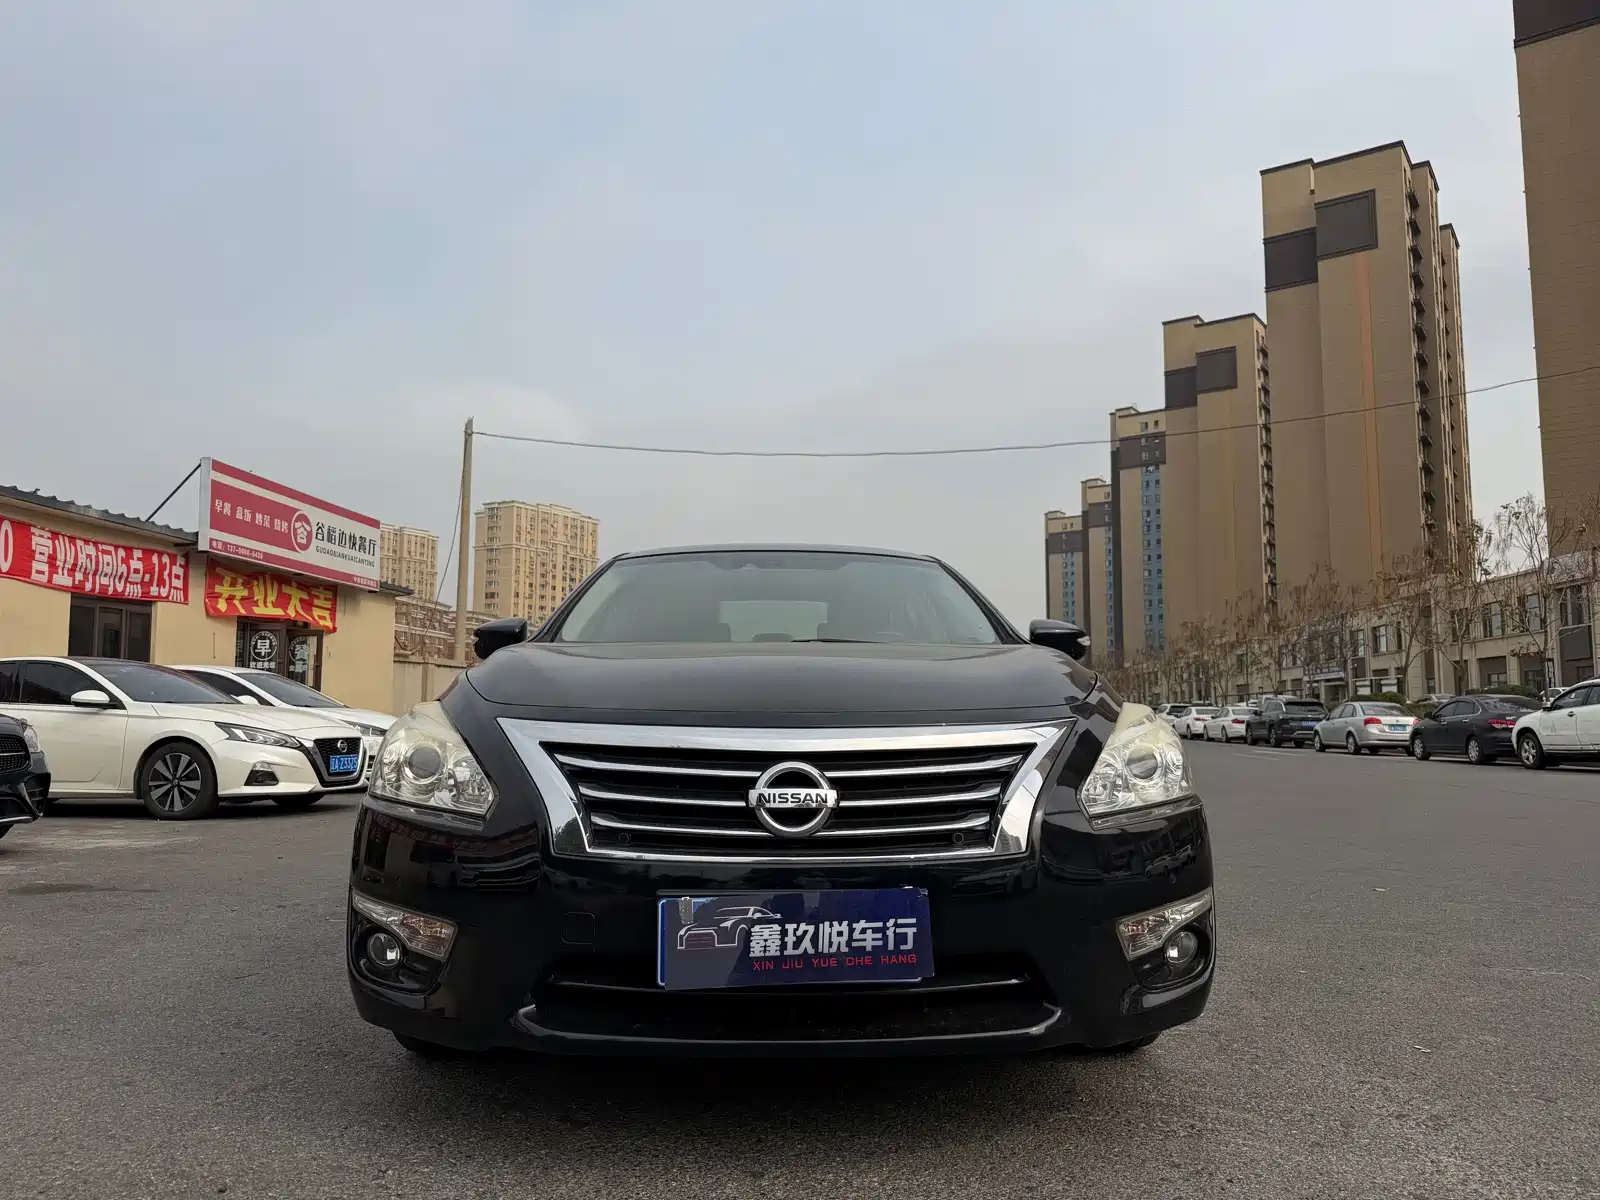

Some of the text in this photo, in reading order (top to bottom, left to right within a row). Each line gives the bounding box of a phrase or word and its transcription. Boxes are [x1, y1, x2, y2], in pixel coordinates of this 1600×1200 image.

[215, 499, 231, 516] 早餐
[236, 506, 252, 522] 盒饭
[315, 521, 377, 556] 谷稻边快餐厅
[30, 525, 186, 602] 营业时间6点-13点
[215, 567, 333, 630] 开业大吉
[255, 639, 271, 656] 早
[757, 792, 828, 804] NISSAN
[749, 917, 918, 958] 鑫玖悦车行
[753, 954, 917, 971] XIN JIU YUE CHE HANG
